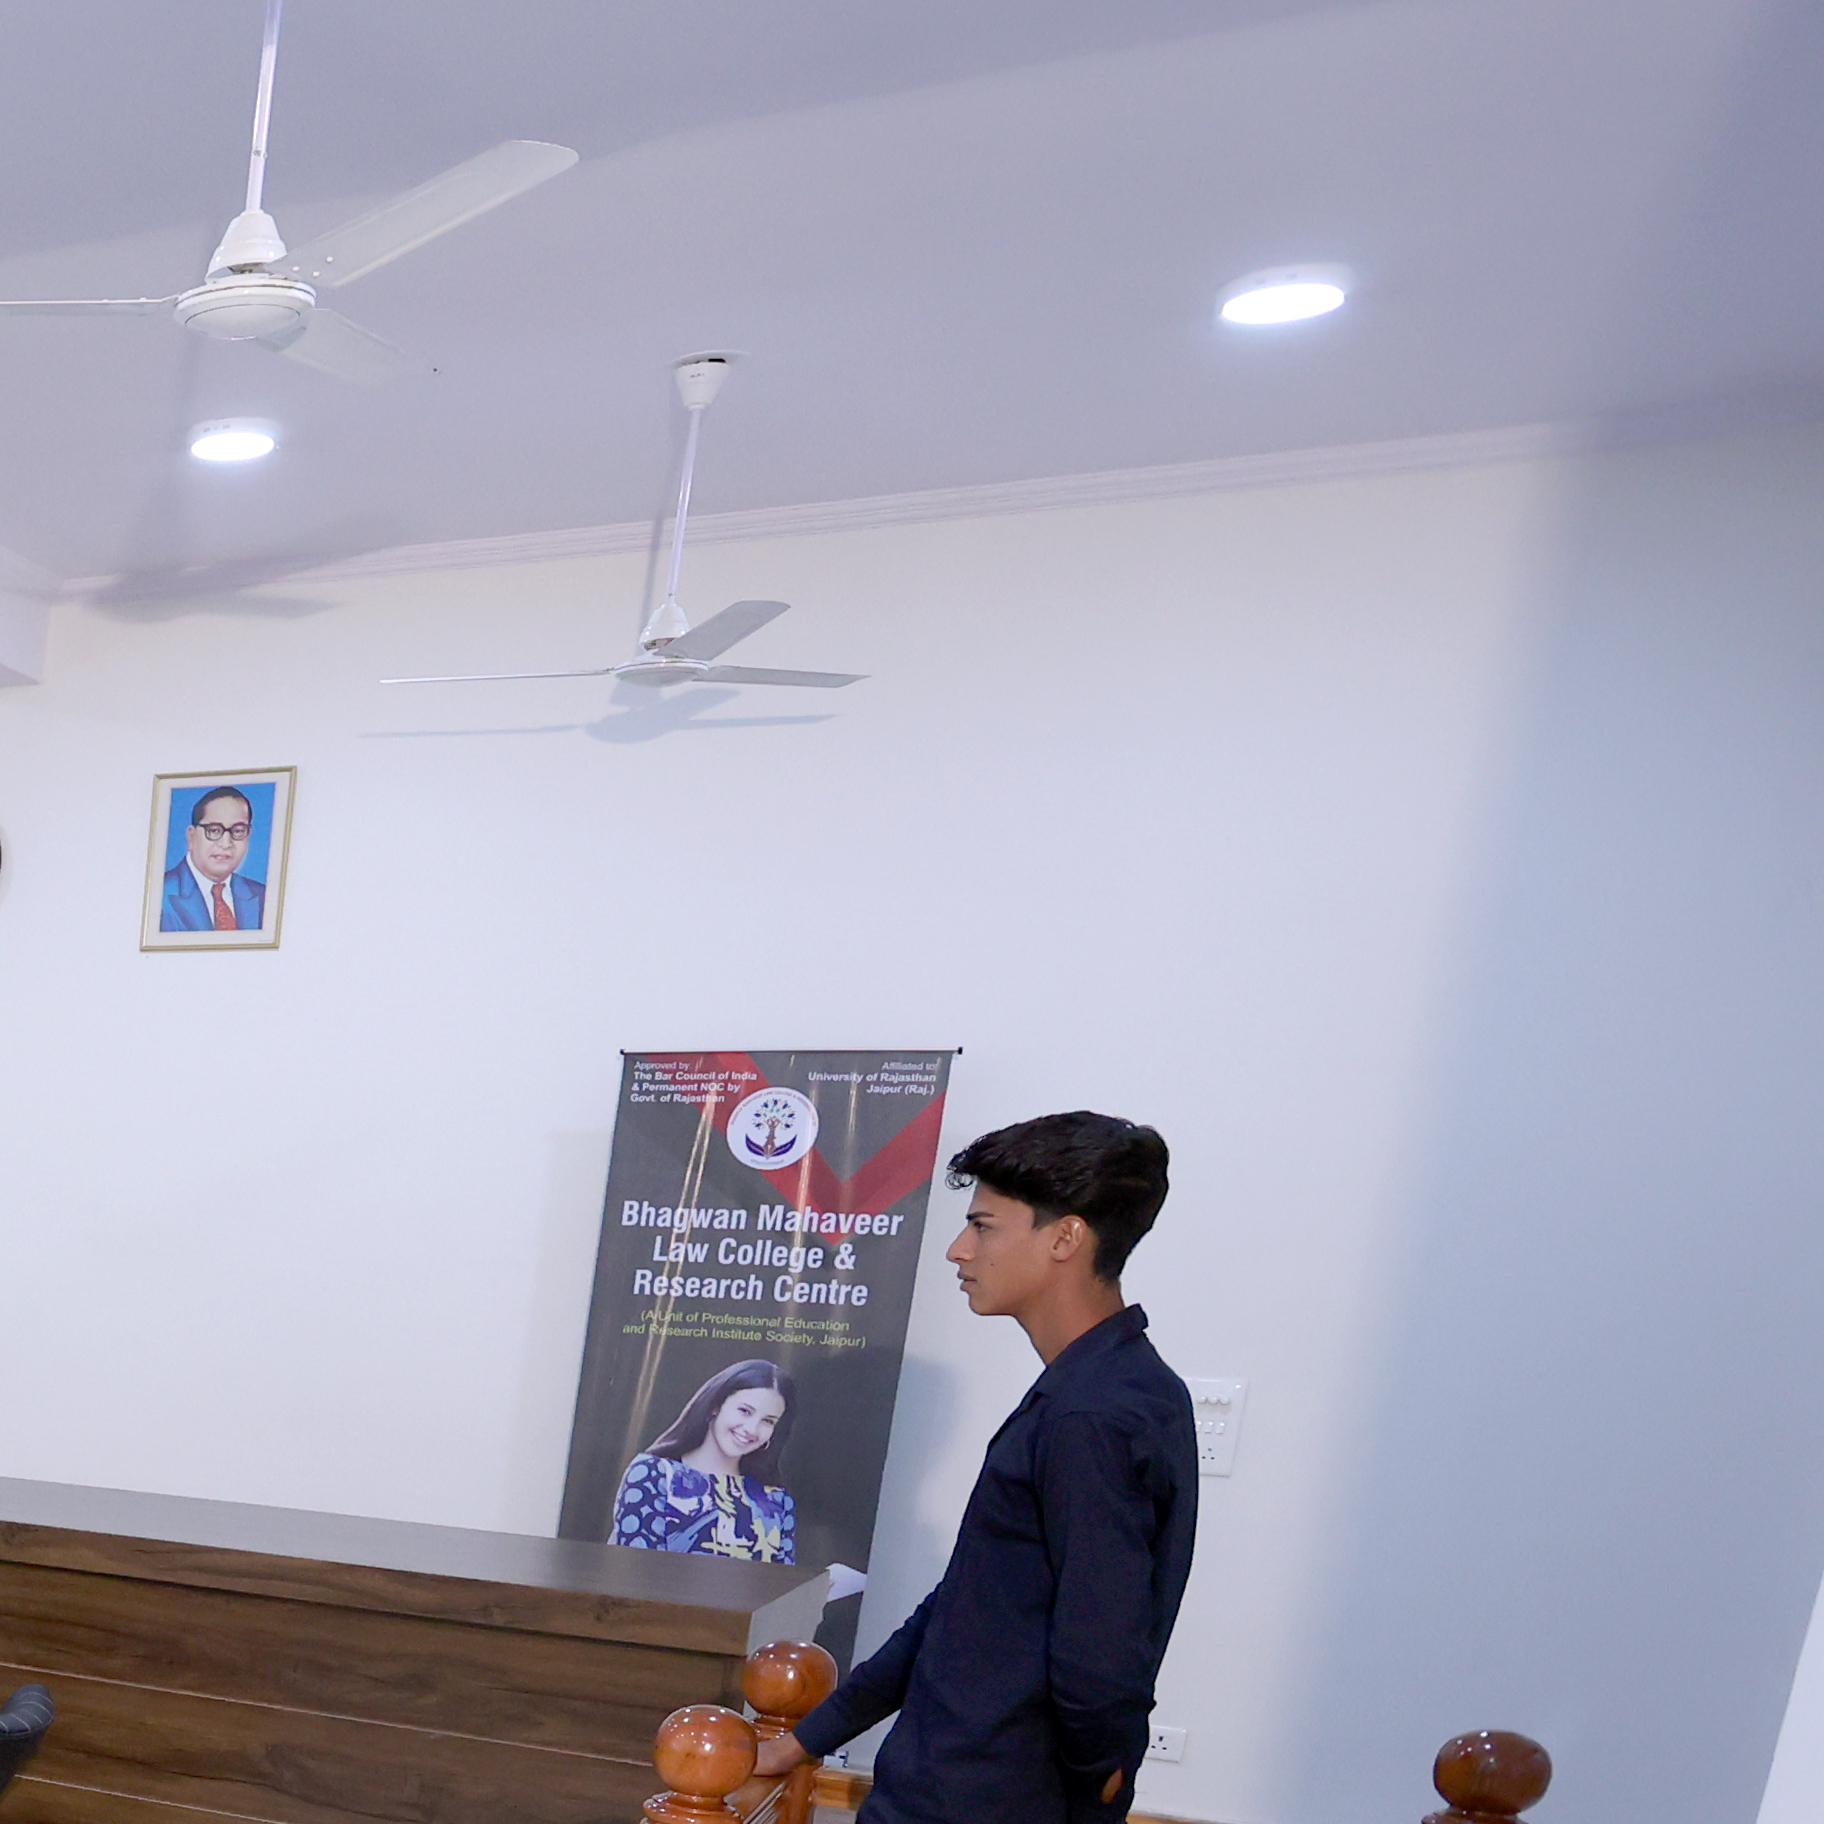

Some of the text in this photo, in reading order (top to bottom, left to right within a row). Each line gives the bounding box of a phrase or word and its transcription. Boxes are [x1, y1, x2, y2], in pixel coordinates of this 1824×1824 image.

[634, 1061, 676, 1071] Approved
[882, 1062, 923, 1071] Affiliated
[634, 1072, 757, 1081] The Bar Council of India
[808, 1072, 936, 1084] University of Rajasthan
[631, 1083, 741, 1093] & Permanent NOC by
[866, 1084, 935, 1096] Jaipur (Raj.)
[660, 1093, 671, 1102] of
[673, 1094, 725, 1104] Rajasthan
[621, 1200, 905, 1236] Bhagwan Mahaveer
[653, 1235, 857, 1273] Law College &
[633, 1269, 870, 1307] Research Centre
[641, 1310, 850, 1331] (A Unit of Professional Education
[622, 1323, 645, 1334] and
[650, 1324, 708, 1338] Research
[711, 1328, 762, 1341] Institute
[819, 1334, 867, 1349] Jaipur)
